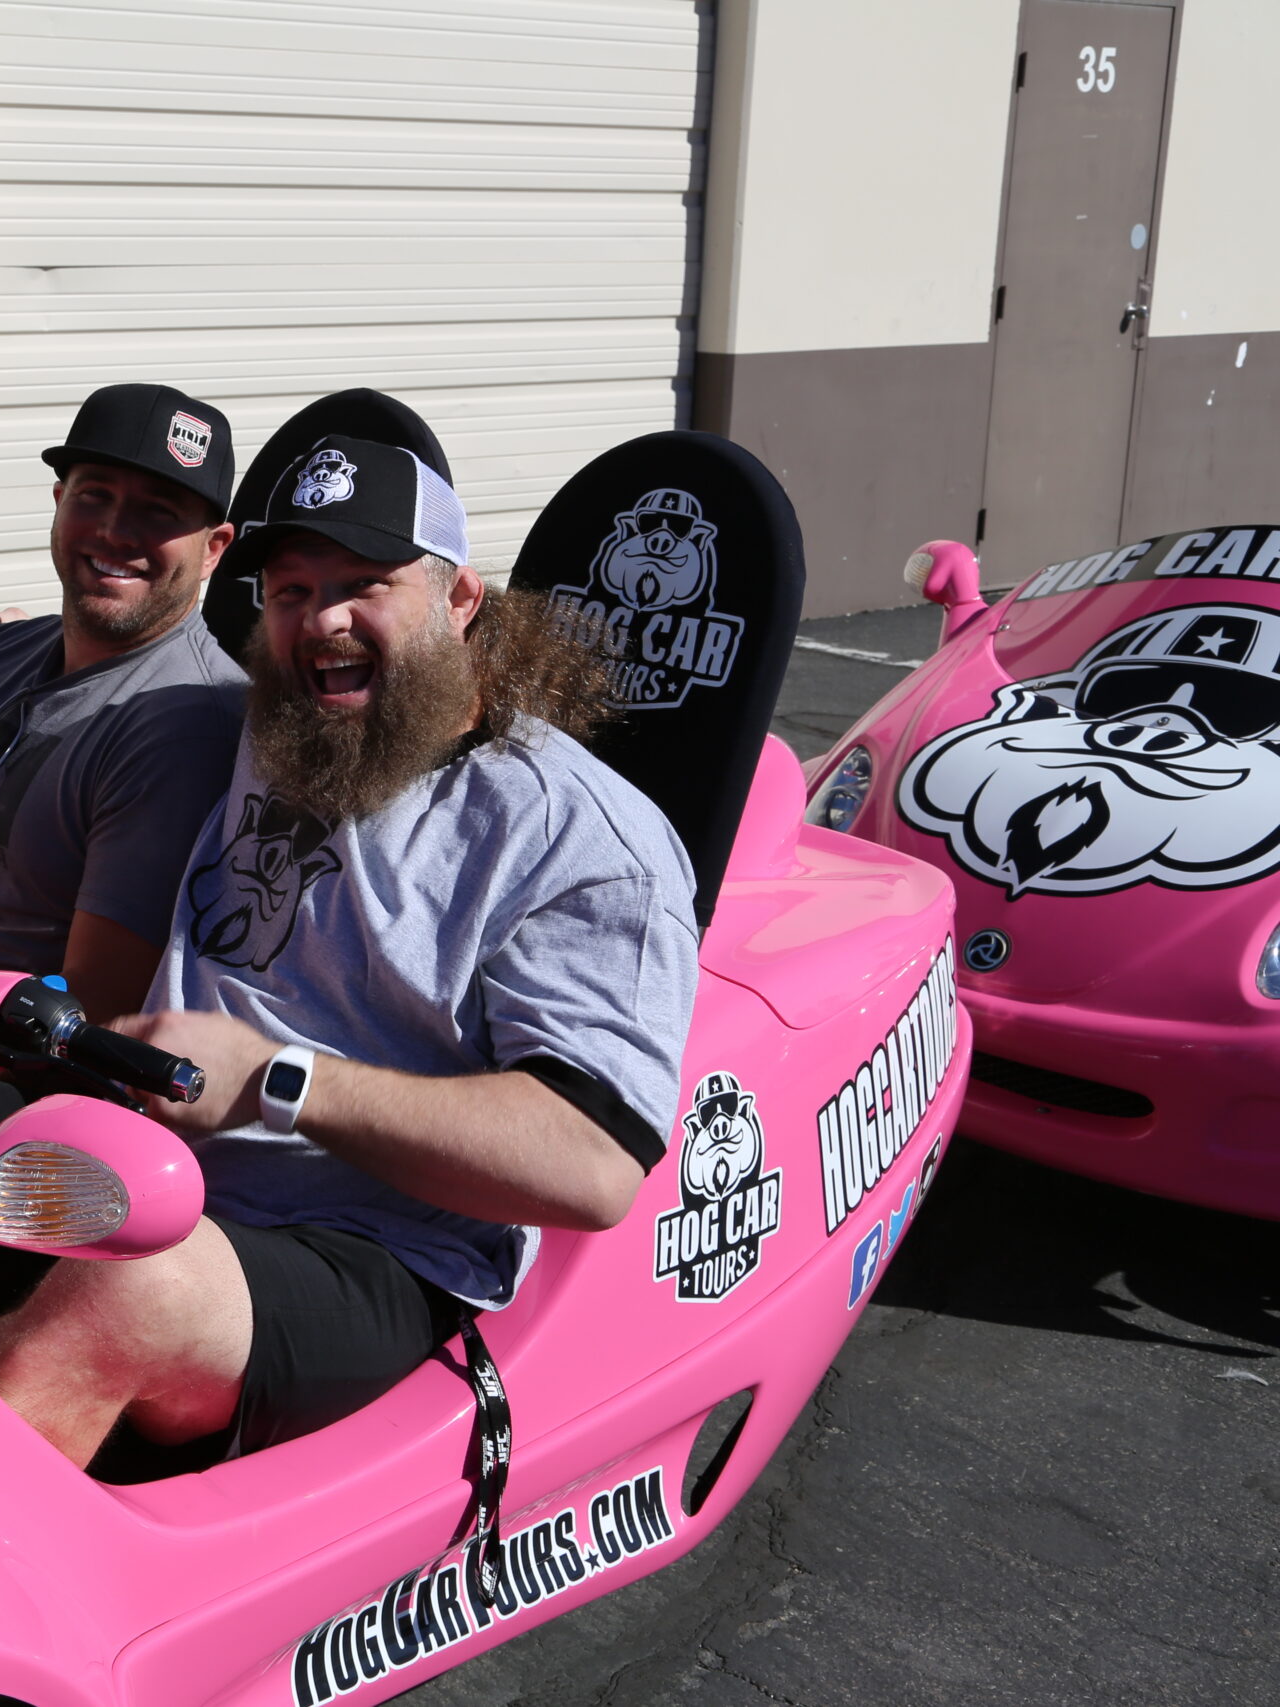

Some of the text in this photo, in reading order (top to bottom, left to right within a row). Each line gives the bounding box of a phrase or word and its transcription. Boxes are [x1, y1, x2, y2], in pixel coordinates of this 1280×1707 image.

[1077, 46, 1117, 93] 35
[1016, 542, 1152, 601] HOG
[641, 613, 732, 677] CAR
[658, 1181, 780, 1273] HOG CAR
[691, 1244, 747, 1297] TOURS
[476, 1366, 500, 1398] UFC
[486, 1440, 495, 1473] UFC
[496, 1430, 507, 1465] UFC
